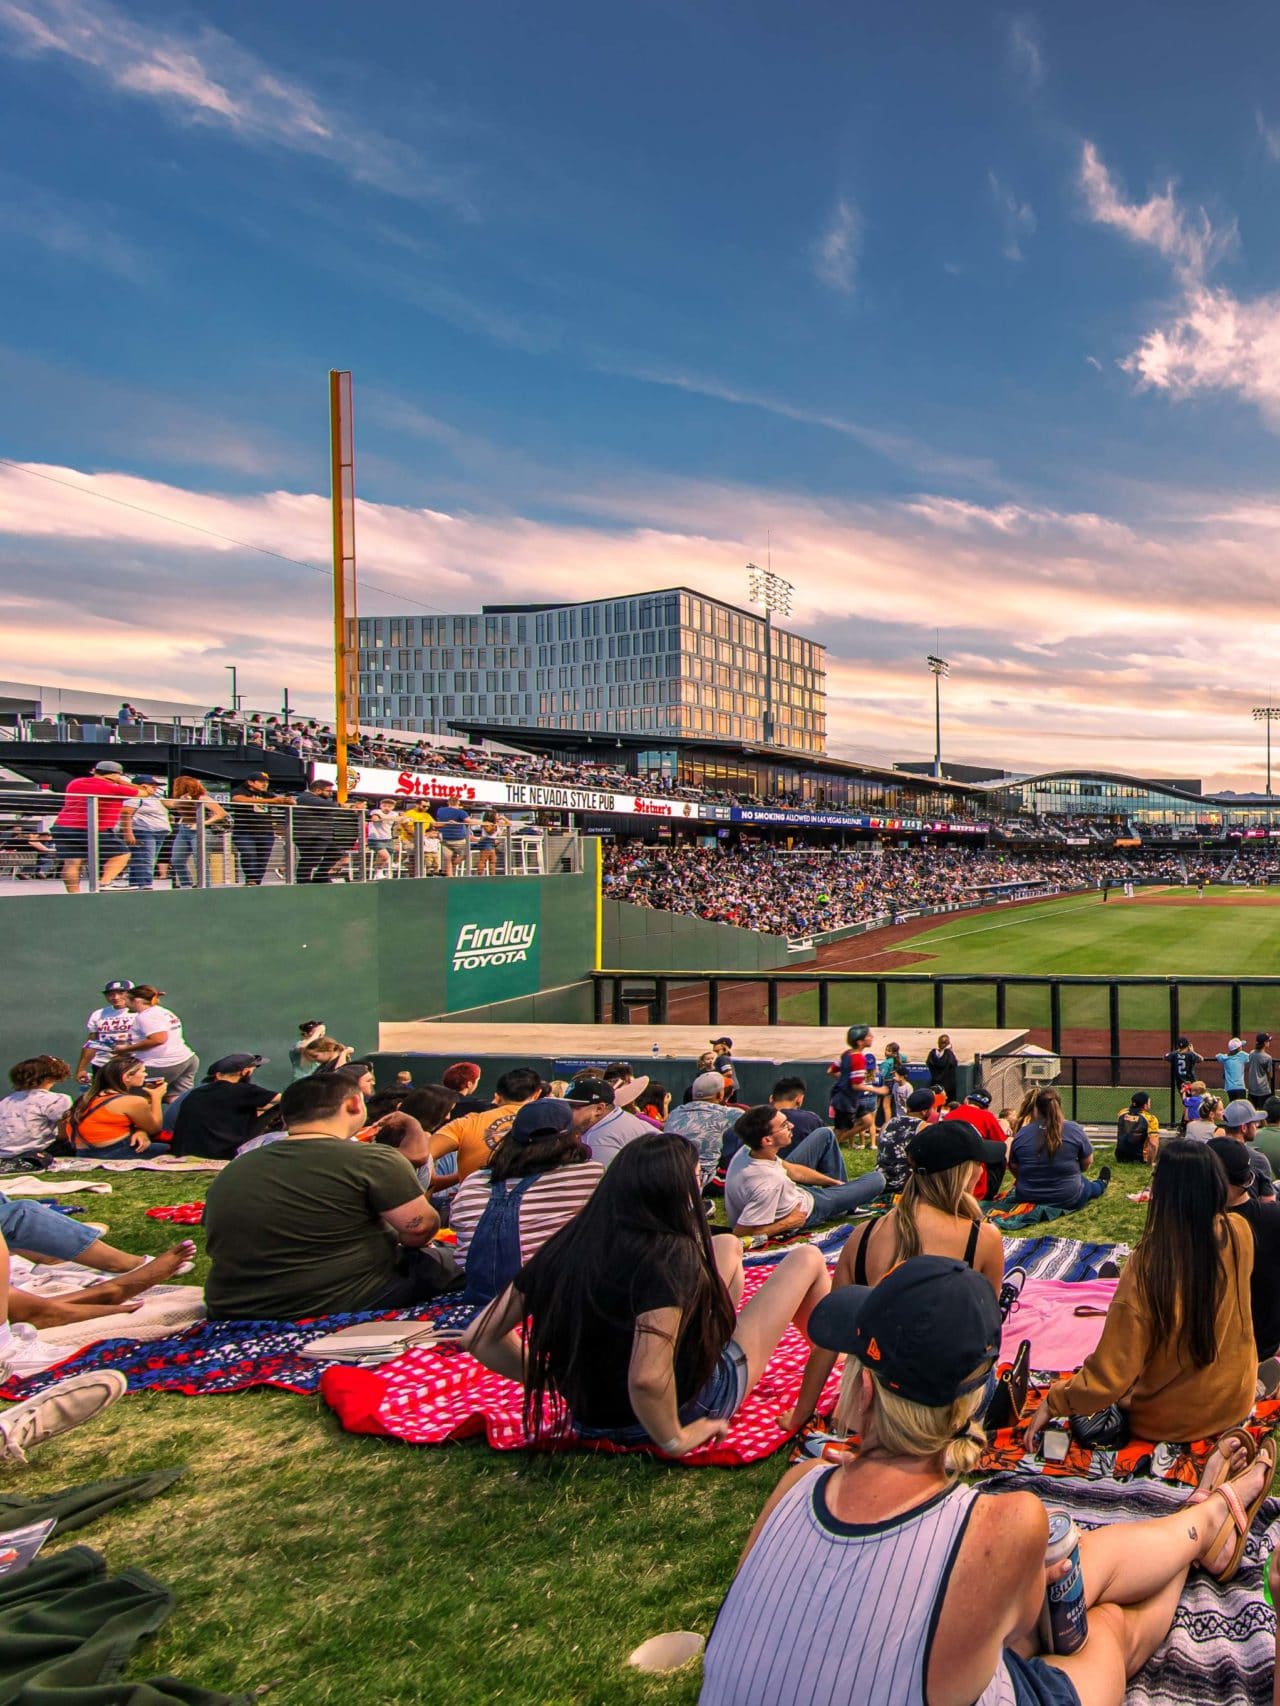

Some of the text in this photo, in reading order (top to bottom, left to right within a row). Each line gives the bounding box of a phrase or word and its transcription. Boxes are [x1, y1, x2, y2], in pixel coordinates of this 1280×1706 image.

[395, 771, 476, 800] Steiner's
[506, 784, 615, 811] THE NEVADA STYLE PUB
[633, 797, 672, 815] Steiner's
[741, 811, 753, 819] NO
[754, 812, 785, 821] SMOKING
[786, 814, 810, 822] ALLOWED
[818, 815, 827, 823] LAS
[827, 816, 841, 824] VEGAS
[455, 920, 537, 950] Findlay
[452, 950, 527, 972] TOYOTA
[102, 1019, 129, 1027] AMY
[1051, 1567, 1079, 1601] BLUE
